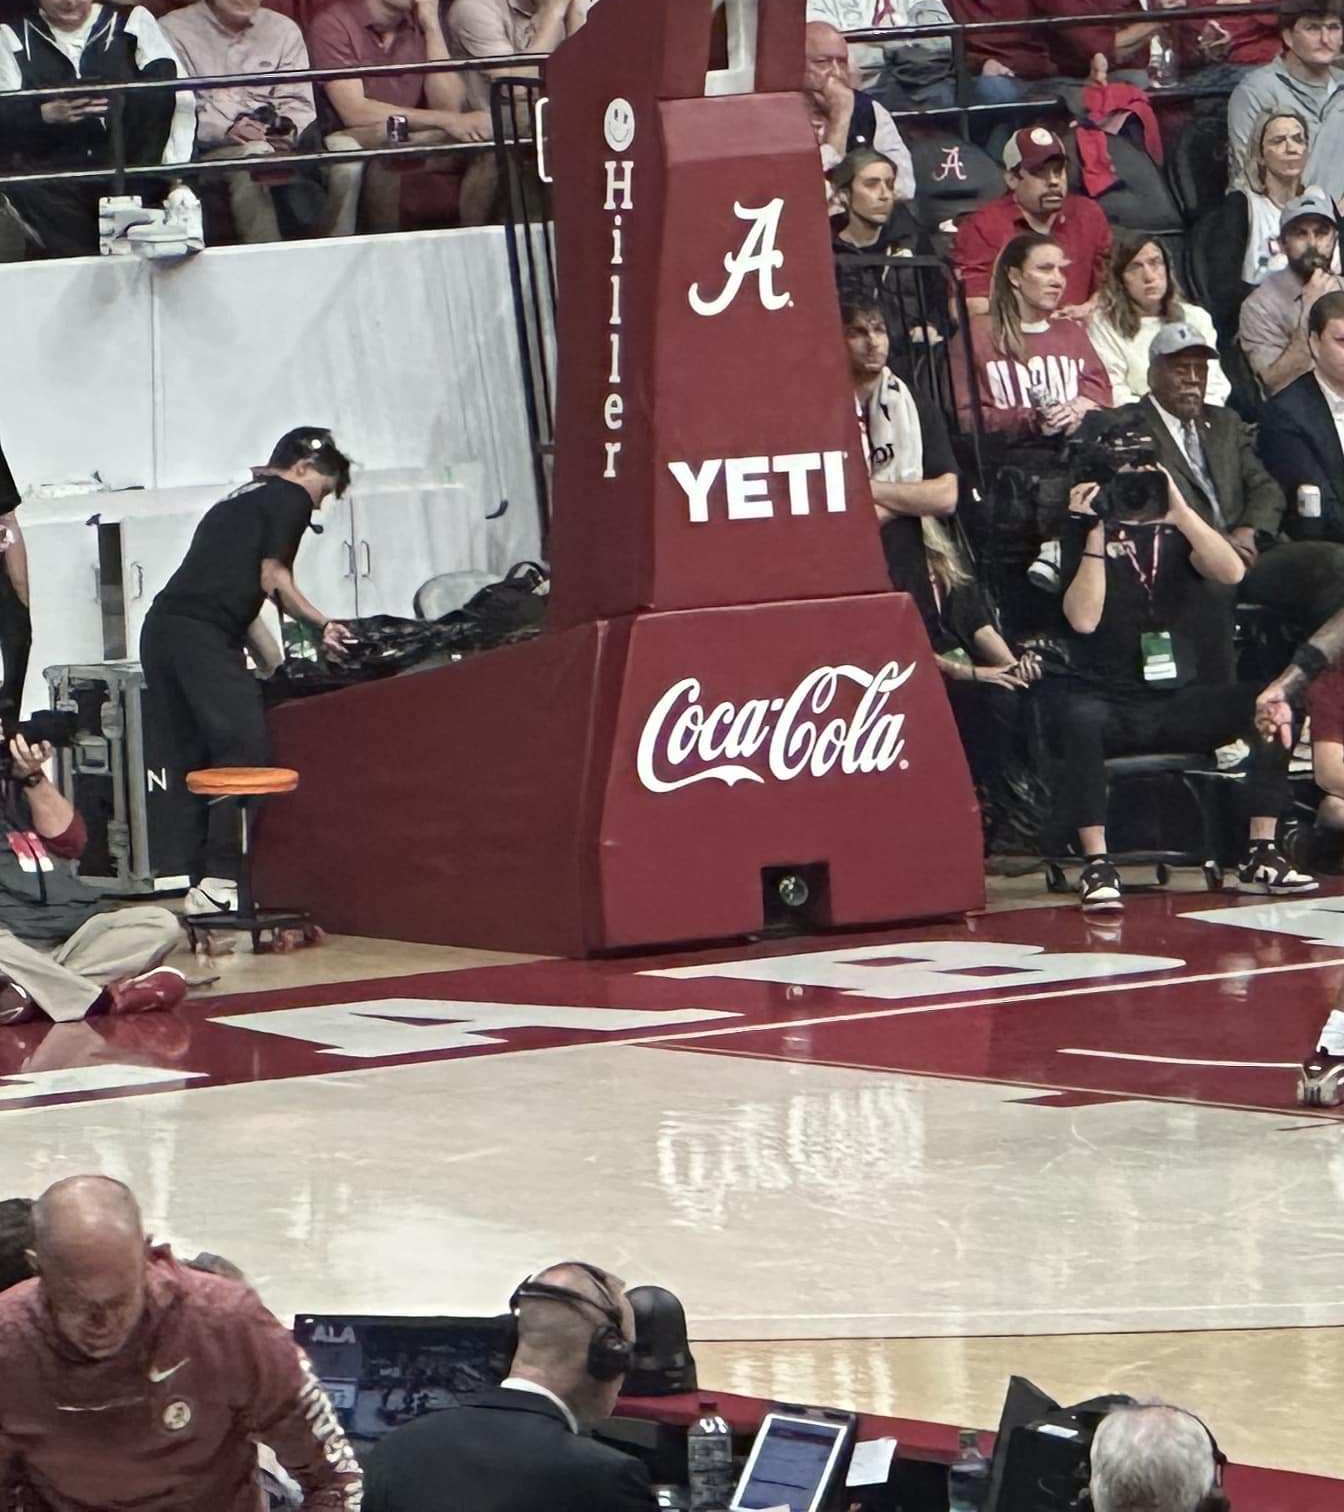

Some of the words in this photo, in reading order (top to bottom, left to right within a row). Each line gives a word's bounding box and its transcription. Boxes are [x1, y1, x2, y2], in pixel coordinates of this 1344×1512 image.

[688, 197, 790, 316] A
[668, 451, 848, 524] YETI
[637, 659, 915, 794] Coca-Cola
